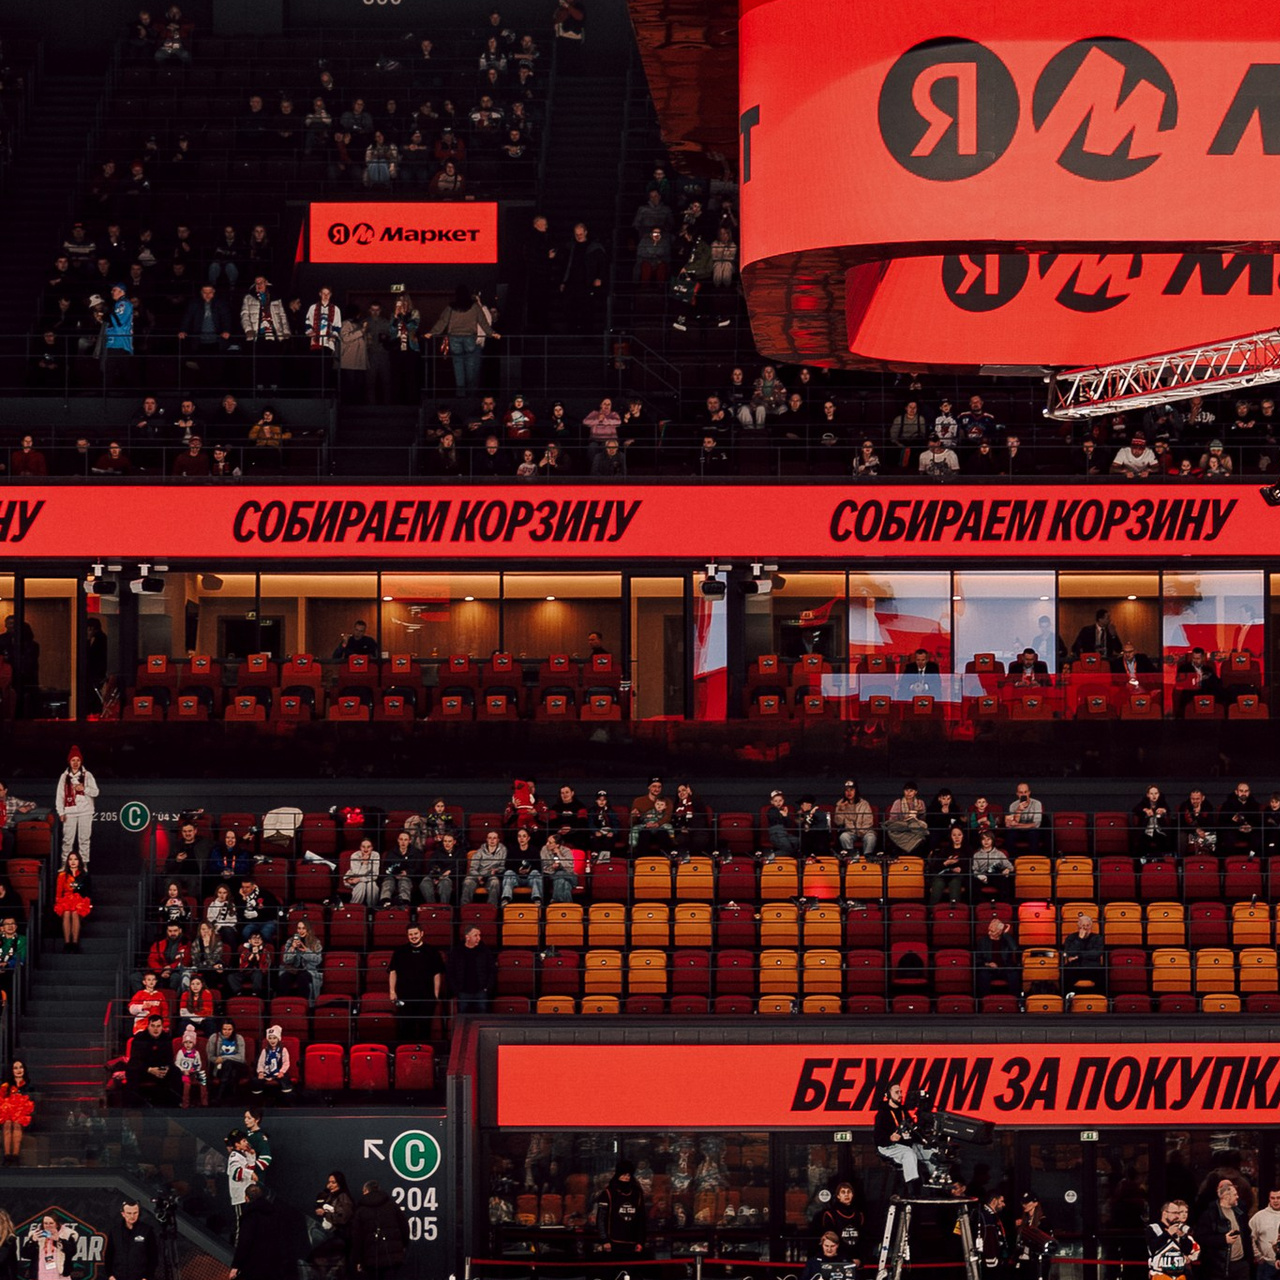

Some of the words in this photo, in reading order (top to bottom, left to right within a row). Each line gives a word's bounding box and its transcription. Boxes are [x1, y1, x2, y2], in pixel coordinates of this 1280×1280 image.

[379, 227, 480, 244] Маркет
[234, 500, 450, 542] СОБИРАЕМ
[451, 500, 641, 542] КОРЗИНУ
[831, 500, 1047, 542] СОБИРАЕМ
[1047, 499, 1238, 542] КОРЗИНУ
[101, 813, 118, 821] 205
[791, 1057, 991, 1112] БЕЖИМ
[994, 1057, 1060, 1111] ЗА
[391, 1187, 438, 1211] 204
[409, 1217, 438, 1241] 05
